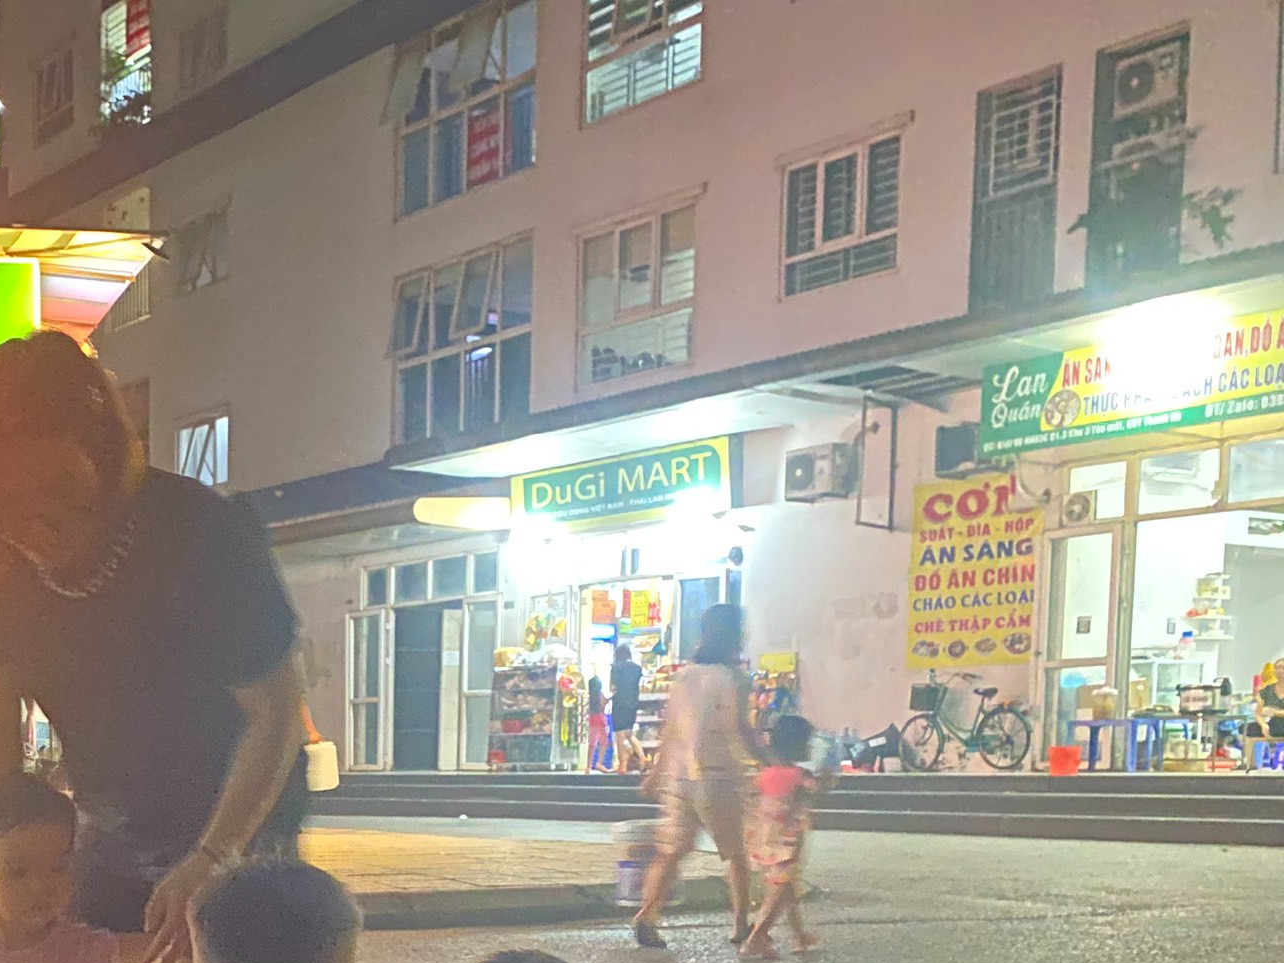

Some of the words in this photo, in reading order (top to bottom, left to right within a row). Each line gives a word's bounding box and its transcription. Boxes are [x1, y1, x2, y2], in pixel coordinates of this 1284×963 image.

[993, 366, 1049, 404] Lan
[531, 471, 605, 509] DuGi
[617, 451, 713, 495] MART
[962, 538, 1034, 562] SÁNG
